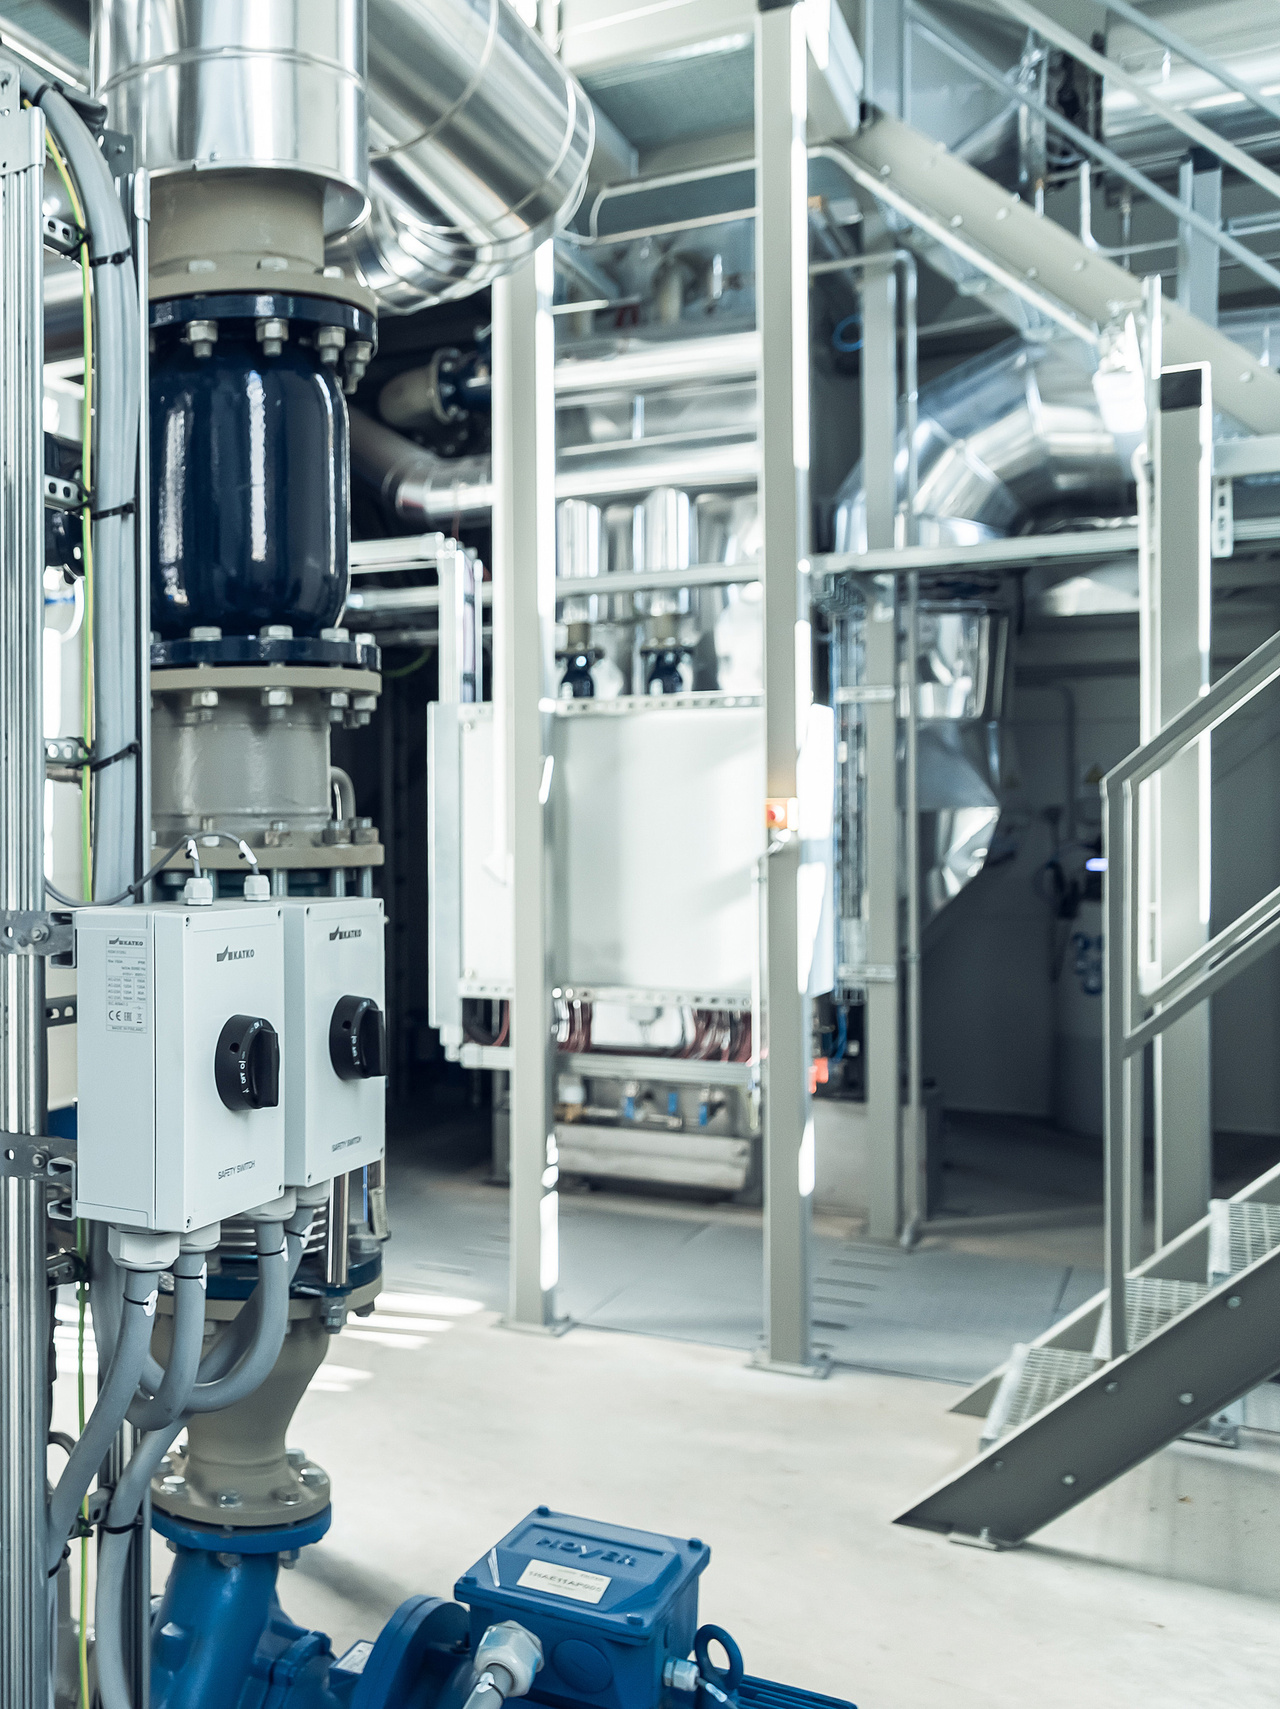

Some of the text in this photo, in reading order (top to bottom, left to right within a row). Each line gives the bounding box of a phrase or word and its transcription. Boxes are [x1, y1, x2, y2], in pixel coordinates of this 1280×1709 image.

[342, 929, 362, 940] KATKO
[233, 948, 255, 960] KATKO
[217, 1159, 256, 1180] SAFETY SWITCH
